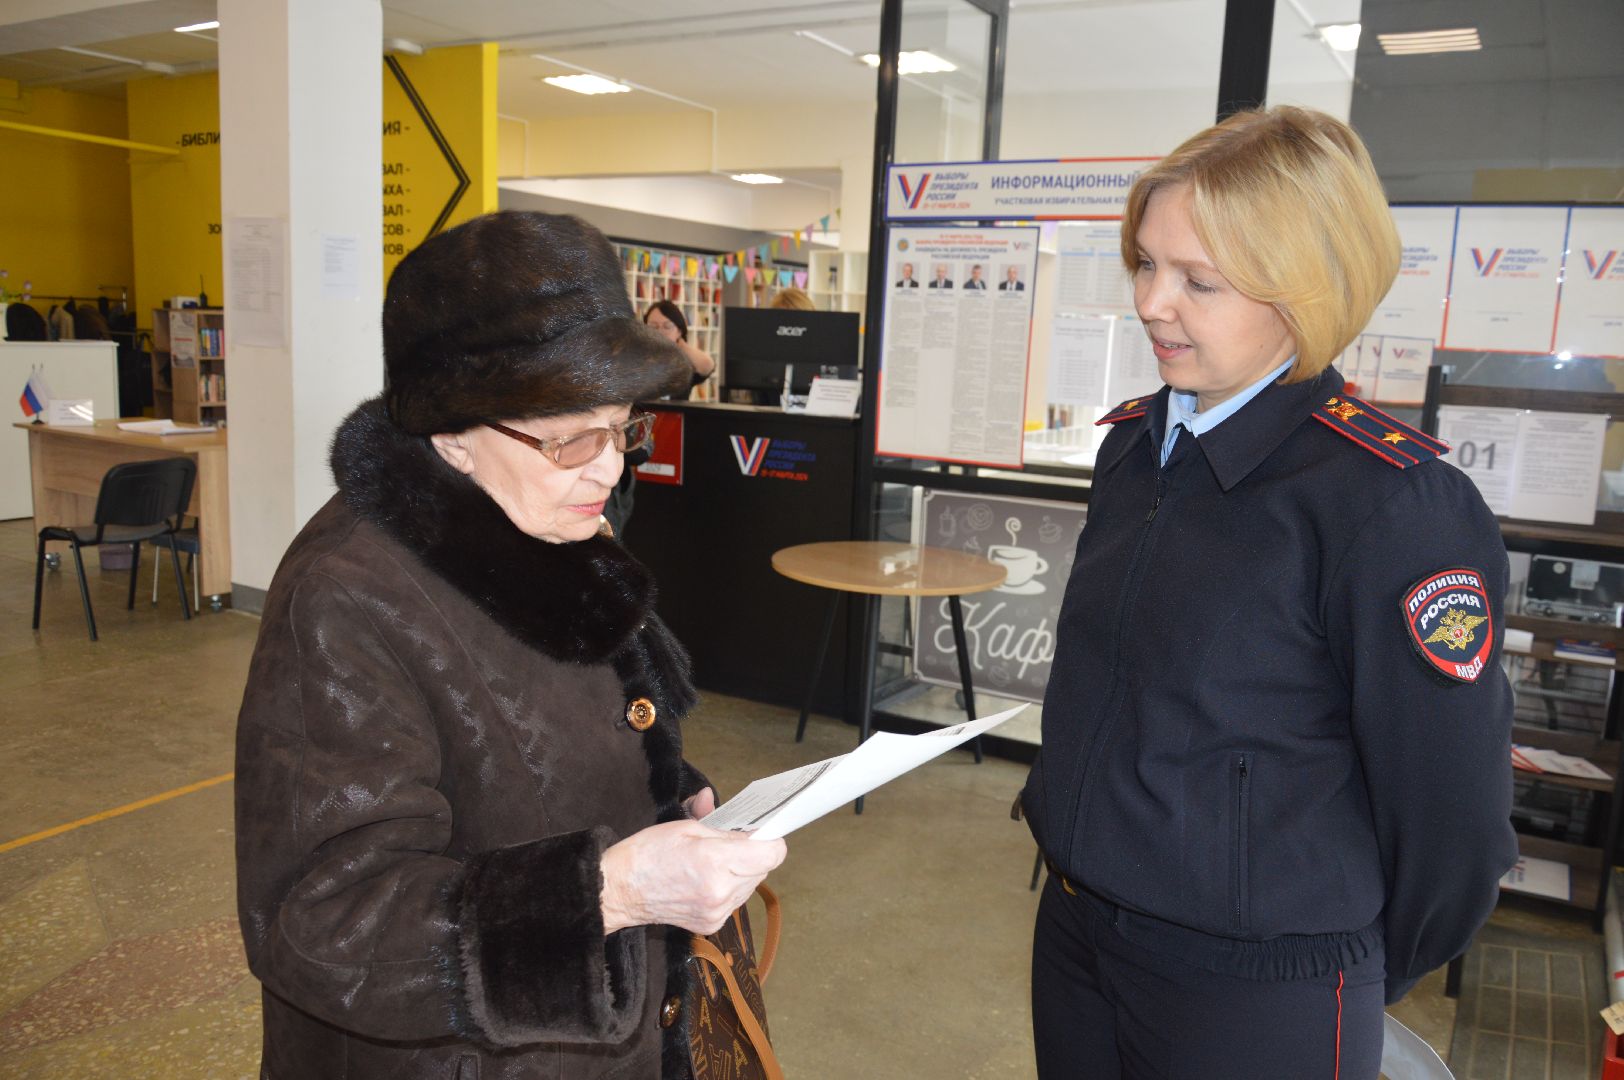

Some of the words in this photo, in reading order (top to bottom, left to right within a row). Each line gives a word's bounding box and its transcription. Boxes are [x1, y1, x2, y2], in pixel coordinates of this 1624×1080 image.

[994, 196, 1043, 205] УЧАСТКОВАЯ
[1045, 196, 1112, 205] ИЗБИРАТЕЛЬНАЯ
[776, 326, 807, 336] acer
[1458, 441, 1496, 470] 01
[1409, 574, 1480, 613] ПОЛИЦИЯ
[1420, 594, 1481, 630] РОССИЯ
[1455, 656, 1483, 679] МВД
